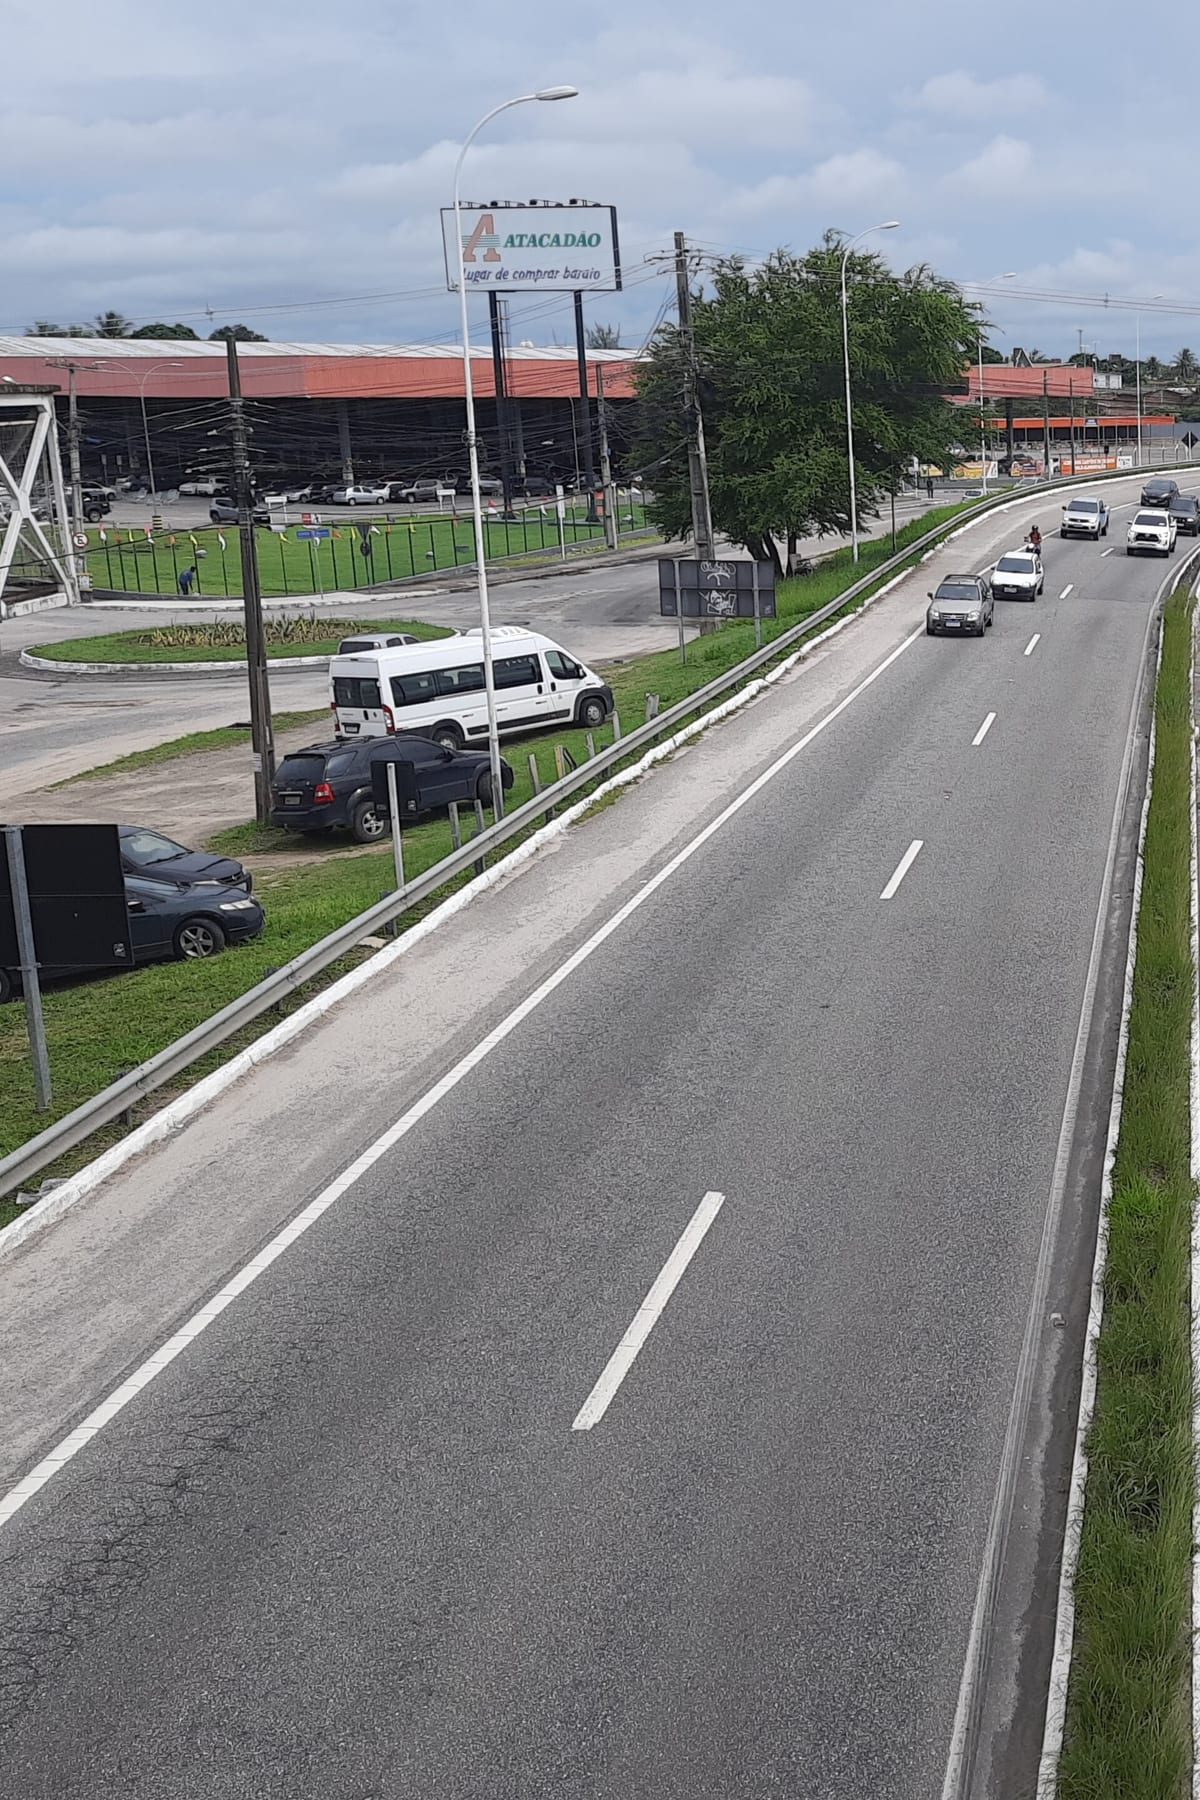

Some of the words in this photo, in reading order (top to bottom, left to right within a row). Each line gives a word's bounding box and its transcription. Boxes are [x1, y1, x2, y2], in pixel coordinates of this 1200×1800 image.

[503, 230, 602, 248] ATACADÃO
[495, 266, 509, 281] de
[512, 268, 560, 283] comprar
